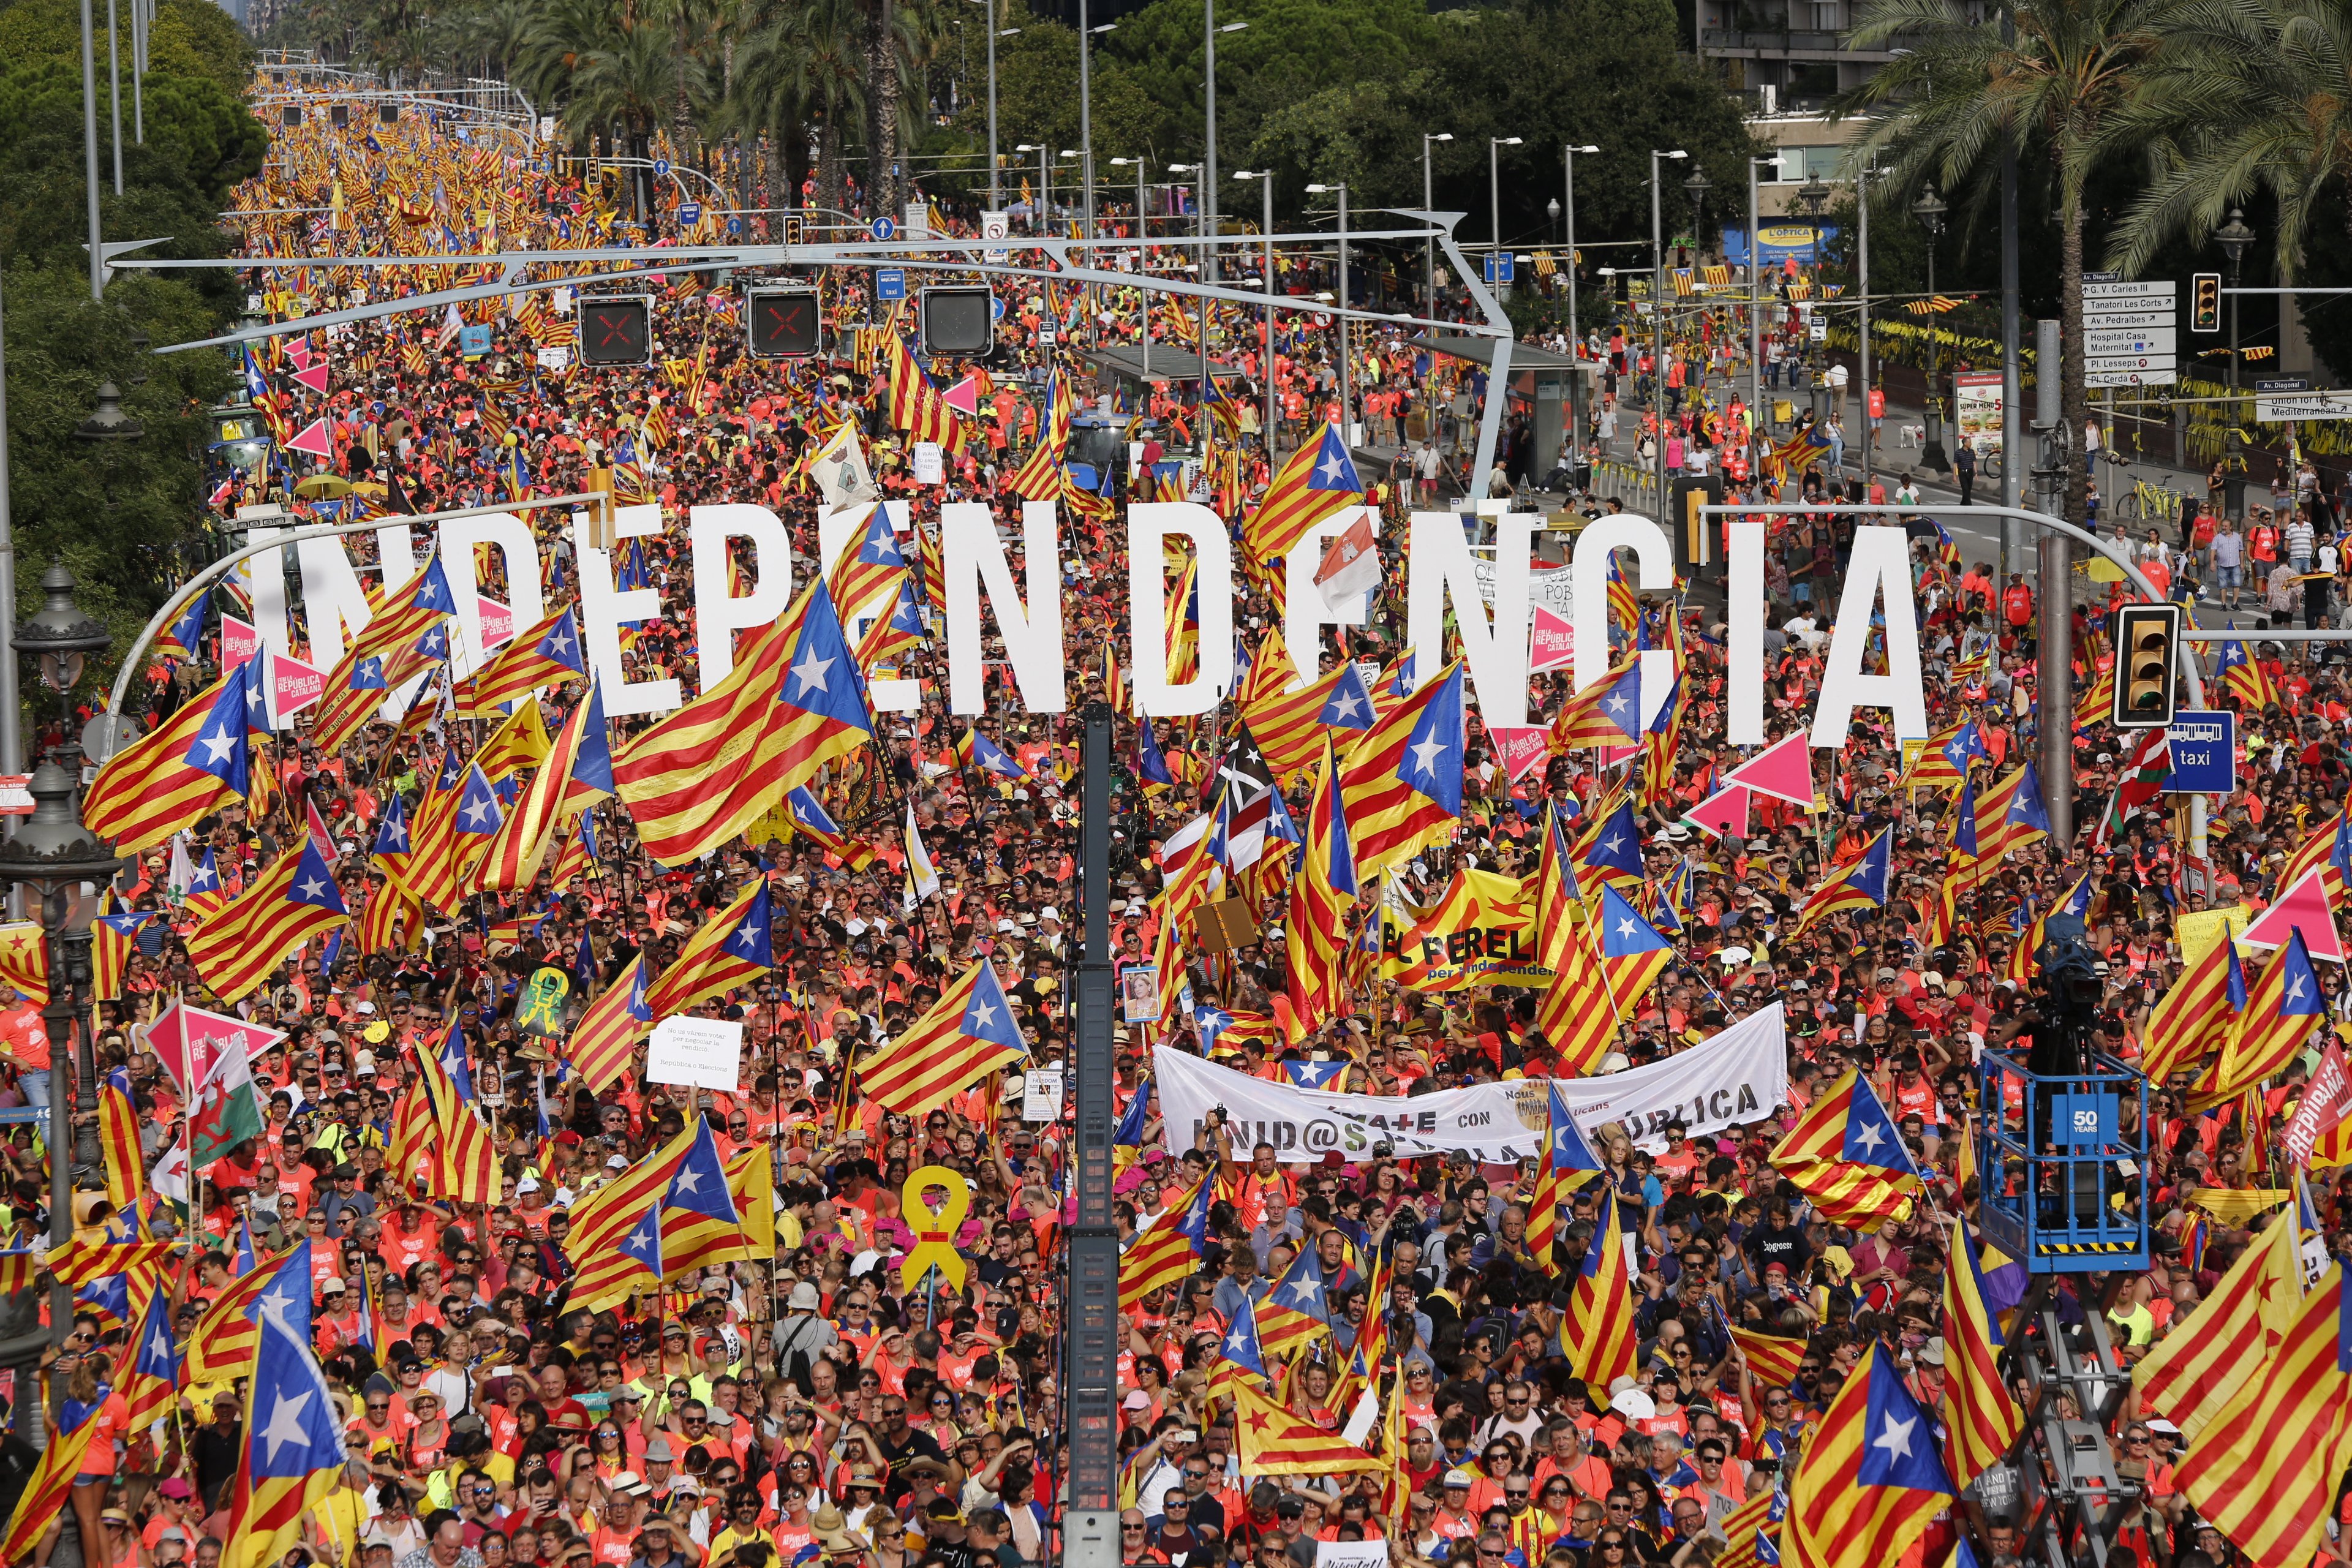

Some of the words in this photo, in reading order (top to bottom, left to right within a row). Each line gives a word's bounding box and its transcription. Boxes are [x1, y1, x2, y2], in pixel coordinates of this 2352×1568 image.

[2106, 315, 2146, 324] Pedralbes
[2091, 333, 2124, 342] Hospital
[2091, 343, 2132, 352] Maternitat
[2104, 359, 2136, 368] Lesseps
[2104, 374, 2128, 383] Cerdà
[2272, 407, 2336, 416] Mediterranean
[489, 622, 514, 635] CATALAN
[226, 638, 256, 652] REPÚBLI
[1536, 631, 1574, 645] REPÚBLIC
[237, 647, 256, 657] CATALA
[1547, 641, 1574, 652] CATALAN
[278, 674, 320, 693] REPÚBLICA
[291, 684, 322, 698] CATALANA
[1517, 739, 1545, 760] CATALANA
[2180, 750, 2211, 766] taxi
[1383, 922, 1412, 964] EL
[1427, 967, 1454, 981] per
[527, 984, 564, 1007] BER
[682, 1044, 709, 1053] rendició.
[685, 1037, 713, 1046] negociar
[660, 1058, 692, 1068] República
[698, 1063, 728, 1072] Eleccions
[1505, 1090, 1535, 1100] Nous
[1458, 1110, 1491, 1128] CON
[2073, 1110, 2098, 1126] 50
[1986, 1473, 2004, 1485] AND
[1715, 1494, 1732, 1514] TV3
[783, 1532, 810, 1546] REPÚBLICA
